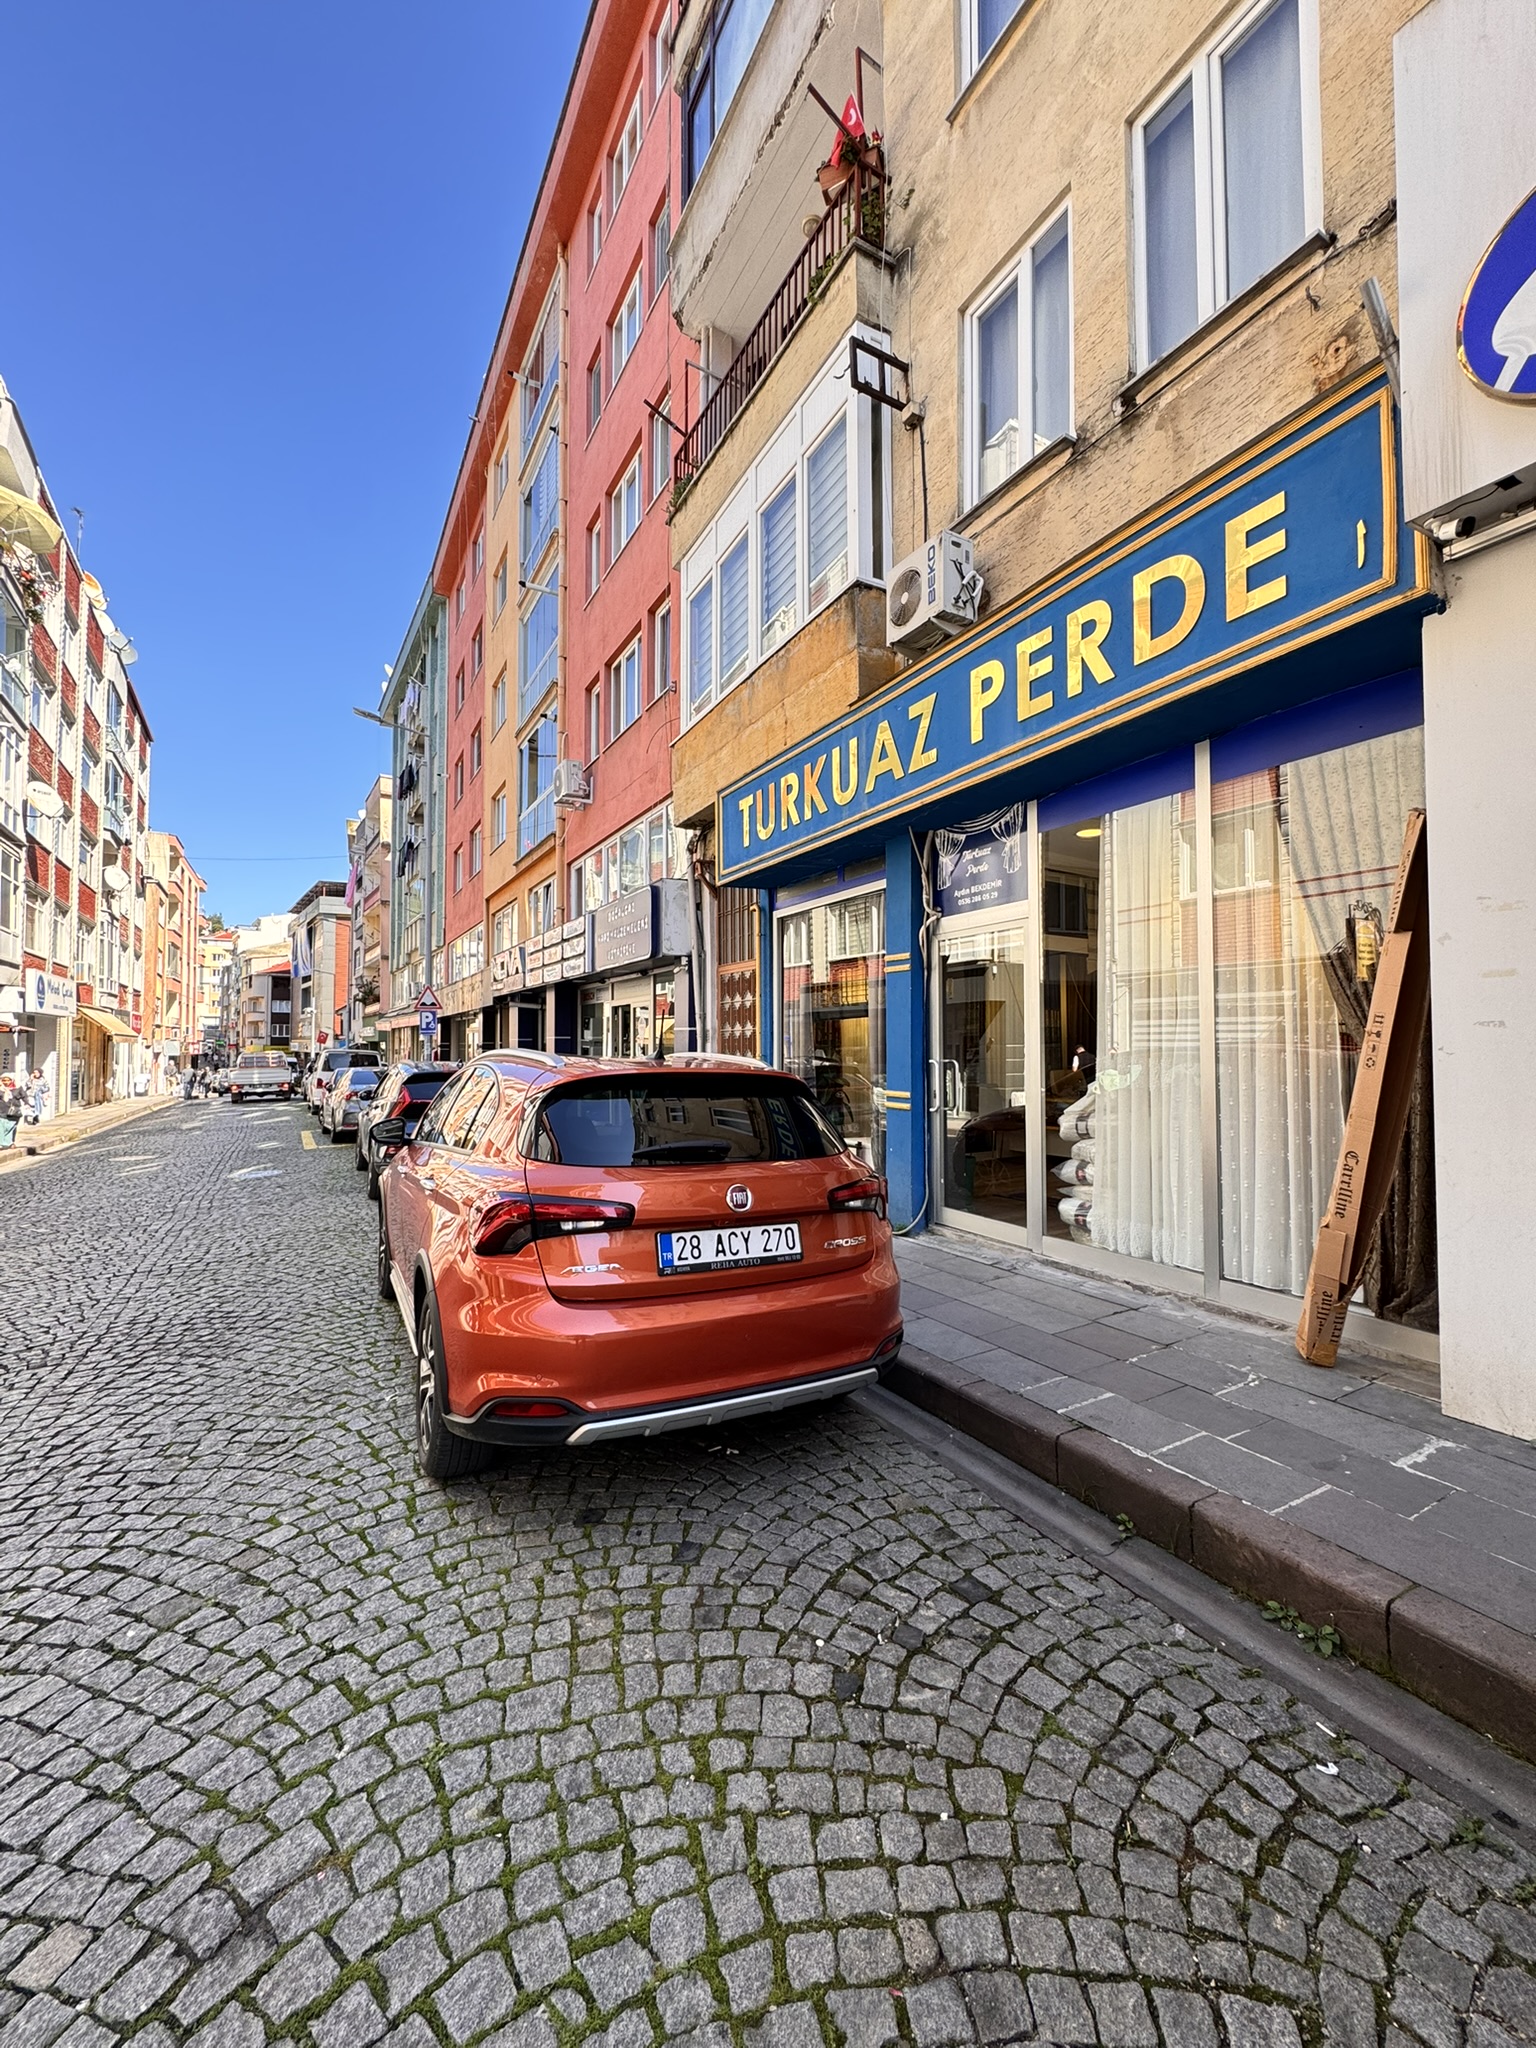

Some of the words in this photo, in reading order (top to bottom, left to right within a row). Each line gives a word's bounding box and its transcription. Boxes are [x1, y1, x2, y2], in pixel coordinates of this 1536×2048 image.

[927, 544, 936, 606] BEKO
[739, 692, 939, 848] TURKUAZ
[970, 490, 1288, 744] PERDE
[1334, 1150, 1360, 1219] Carrlline
[732, 1191, 747, 1206] FIAT
[676, 1235, 702, 1262] 28
[715, 1230, 751, 1258] ACY
[761, 1226, 796, 1253] 270
[823, 1234, 867, 1249] CROSS
[662, 1252, 673, 1261] TR
[710, 1259, 736, 1270] REHA
[738, 1257, 761, 1267] AUTO
